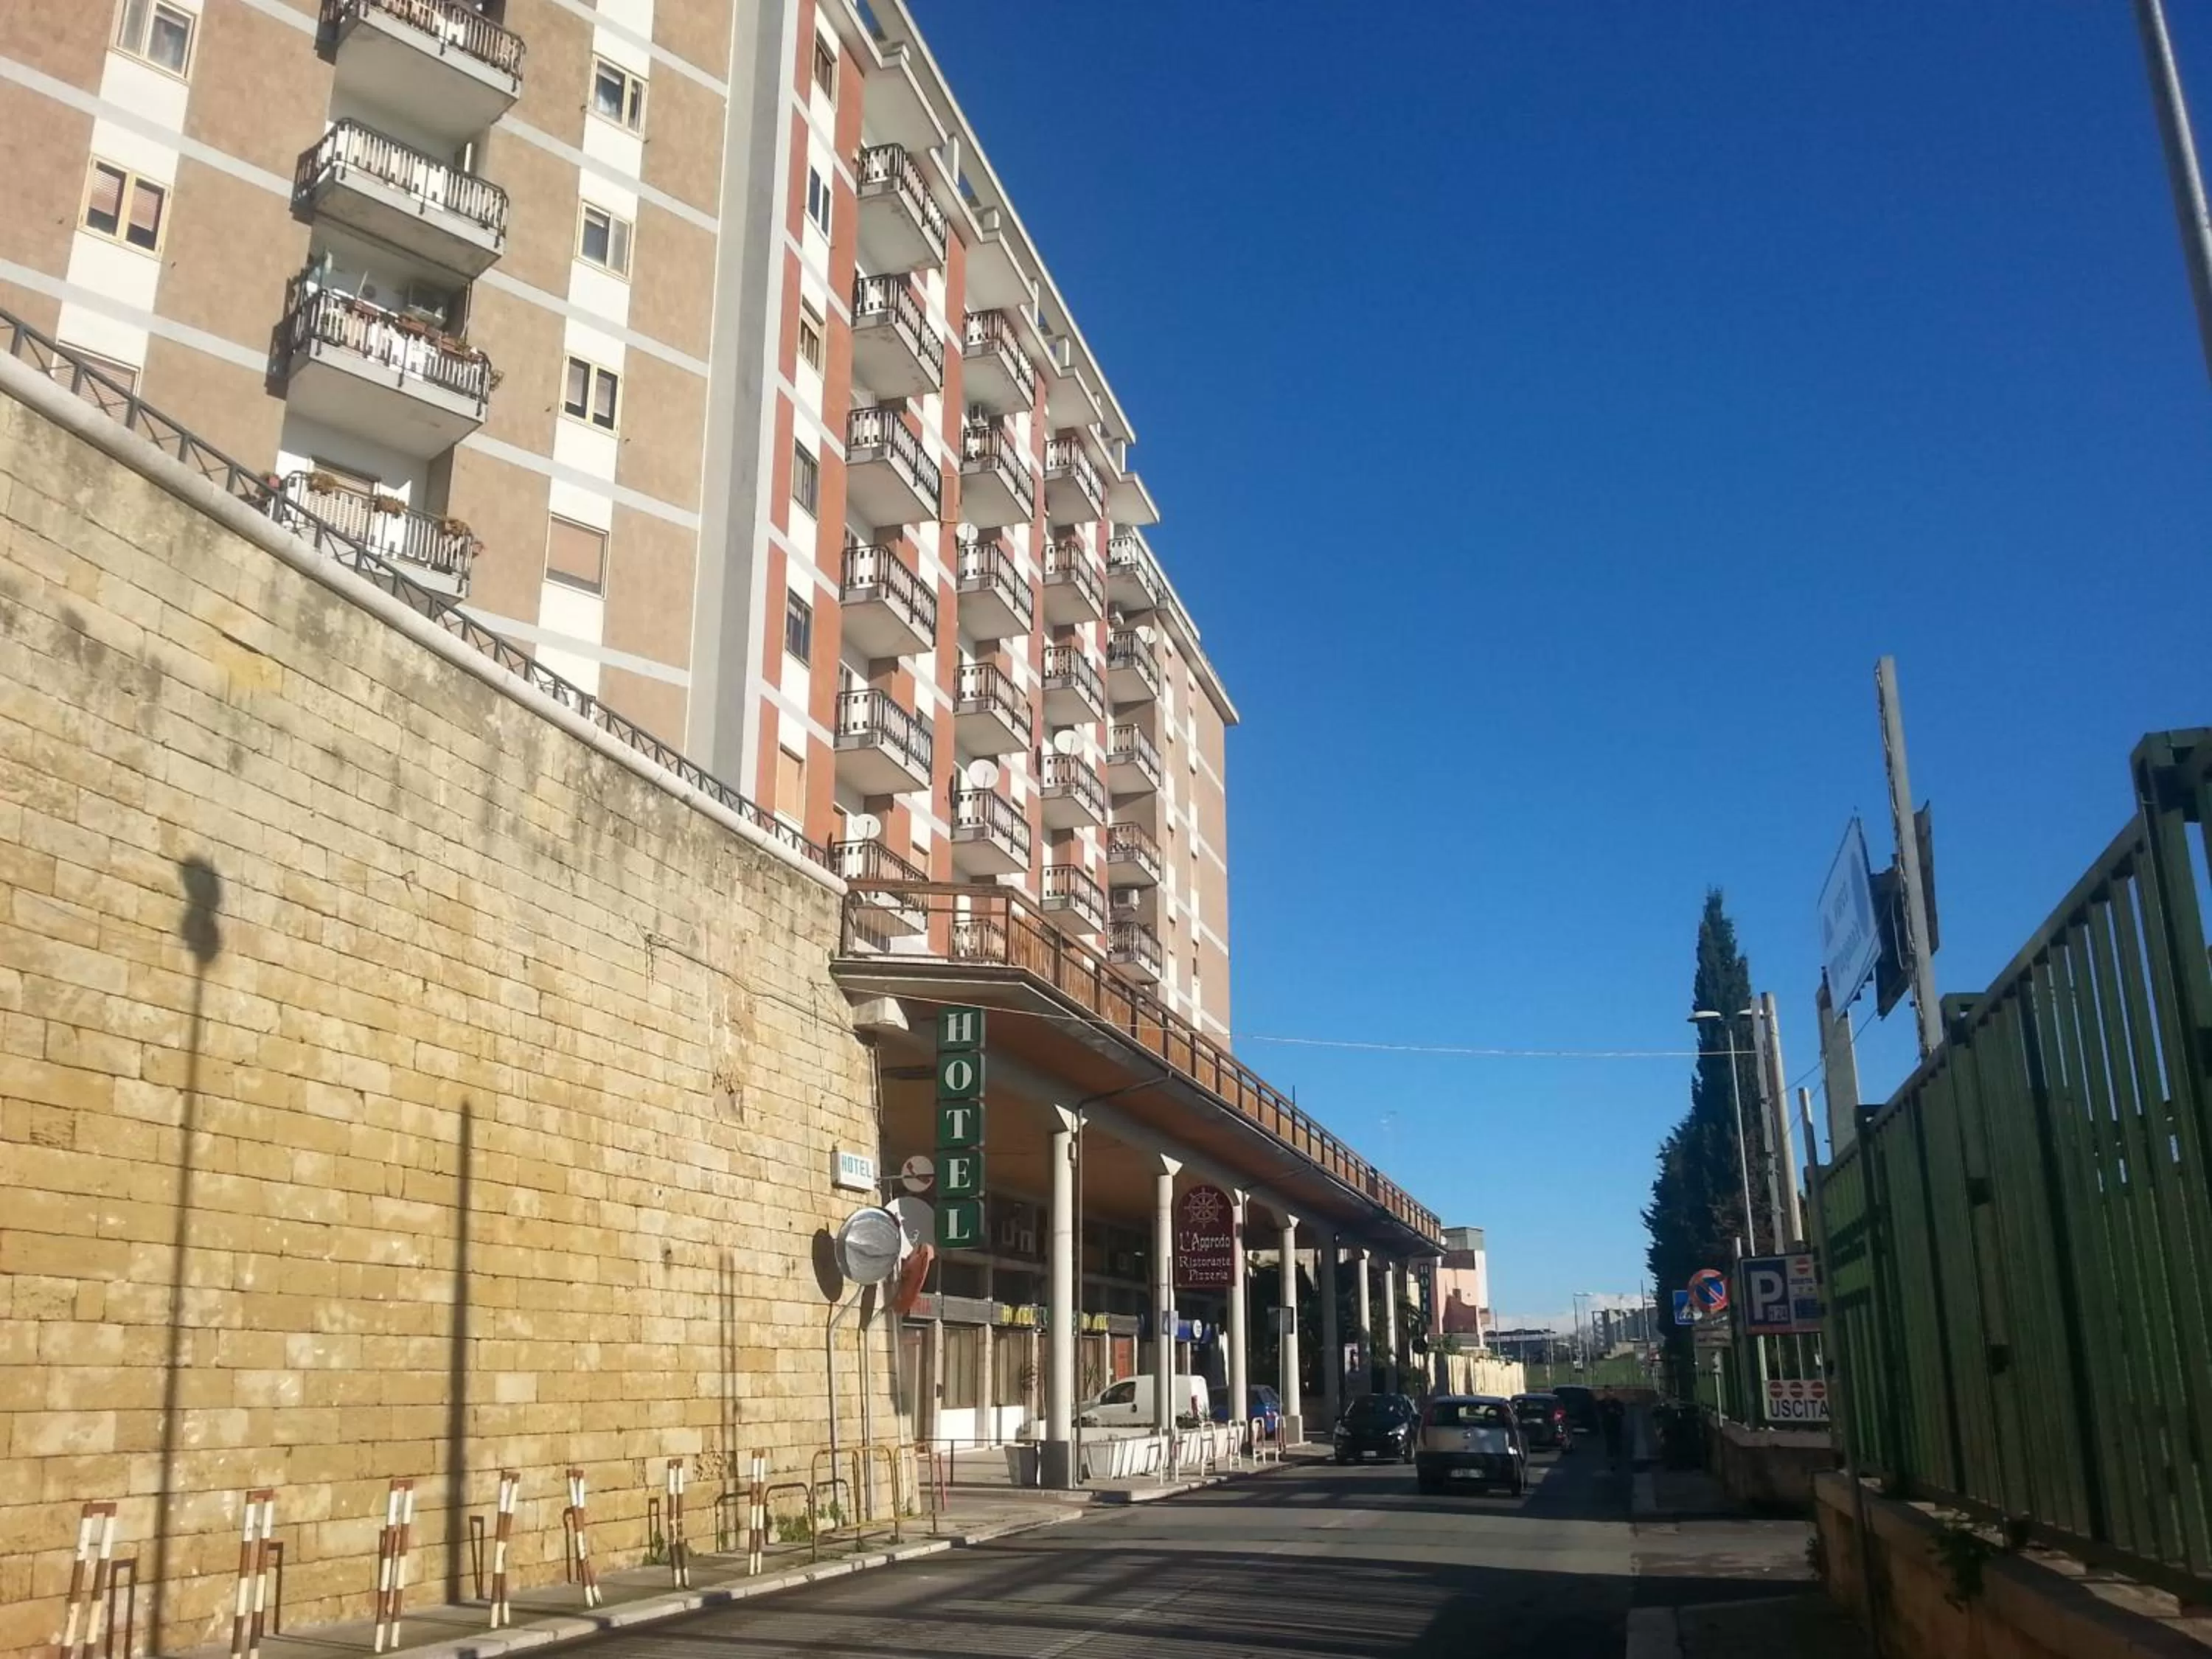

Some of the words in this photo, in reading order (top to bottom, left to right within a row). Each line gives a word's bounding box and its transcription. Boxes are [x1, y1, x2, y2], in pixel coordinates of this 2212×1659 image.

[945, 1012, 973, 1240] HOTEL
[841, 1155, 872, 1179] HOTEL
[1179, 1231, 1231, 1252] L'Approdo
[1179, 1255, 1231, 1268] Ristorante
[1188, 1268, 1228, 1281] Pizzeria
[1770, 1399, 1829, 1418] USCITA
